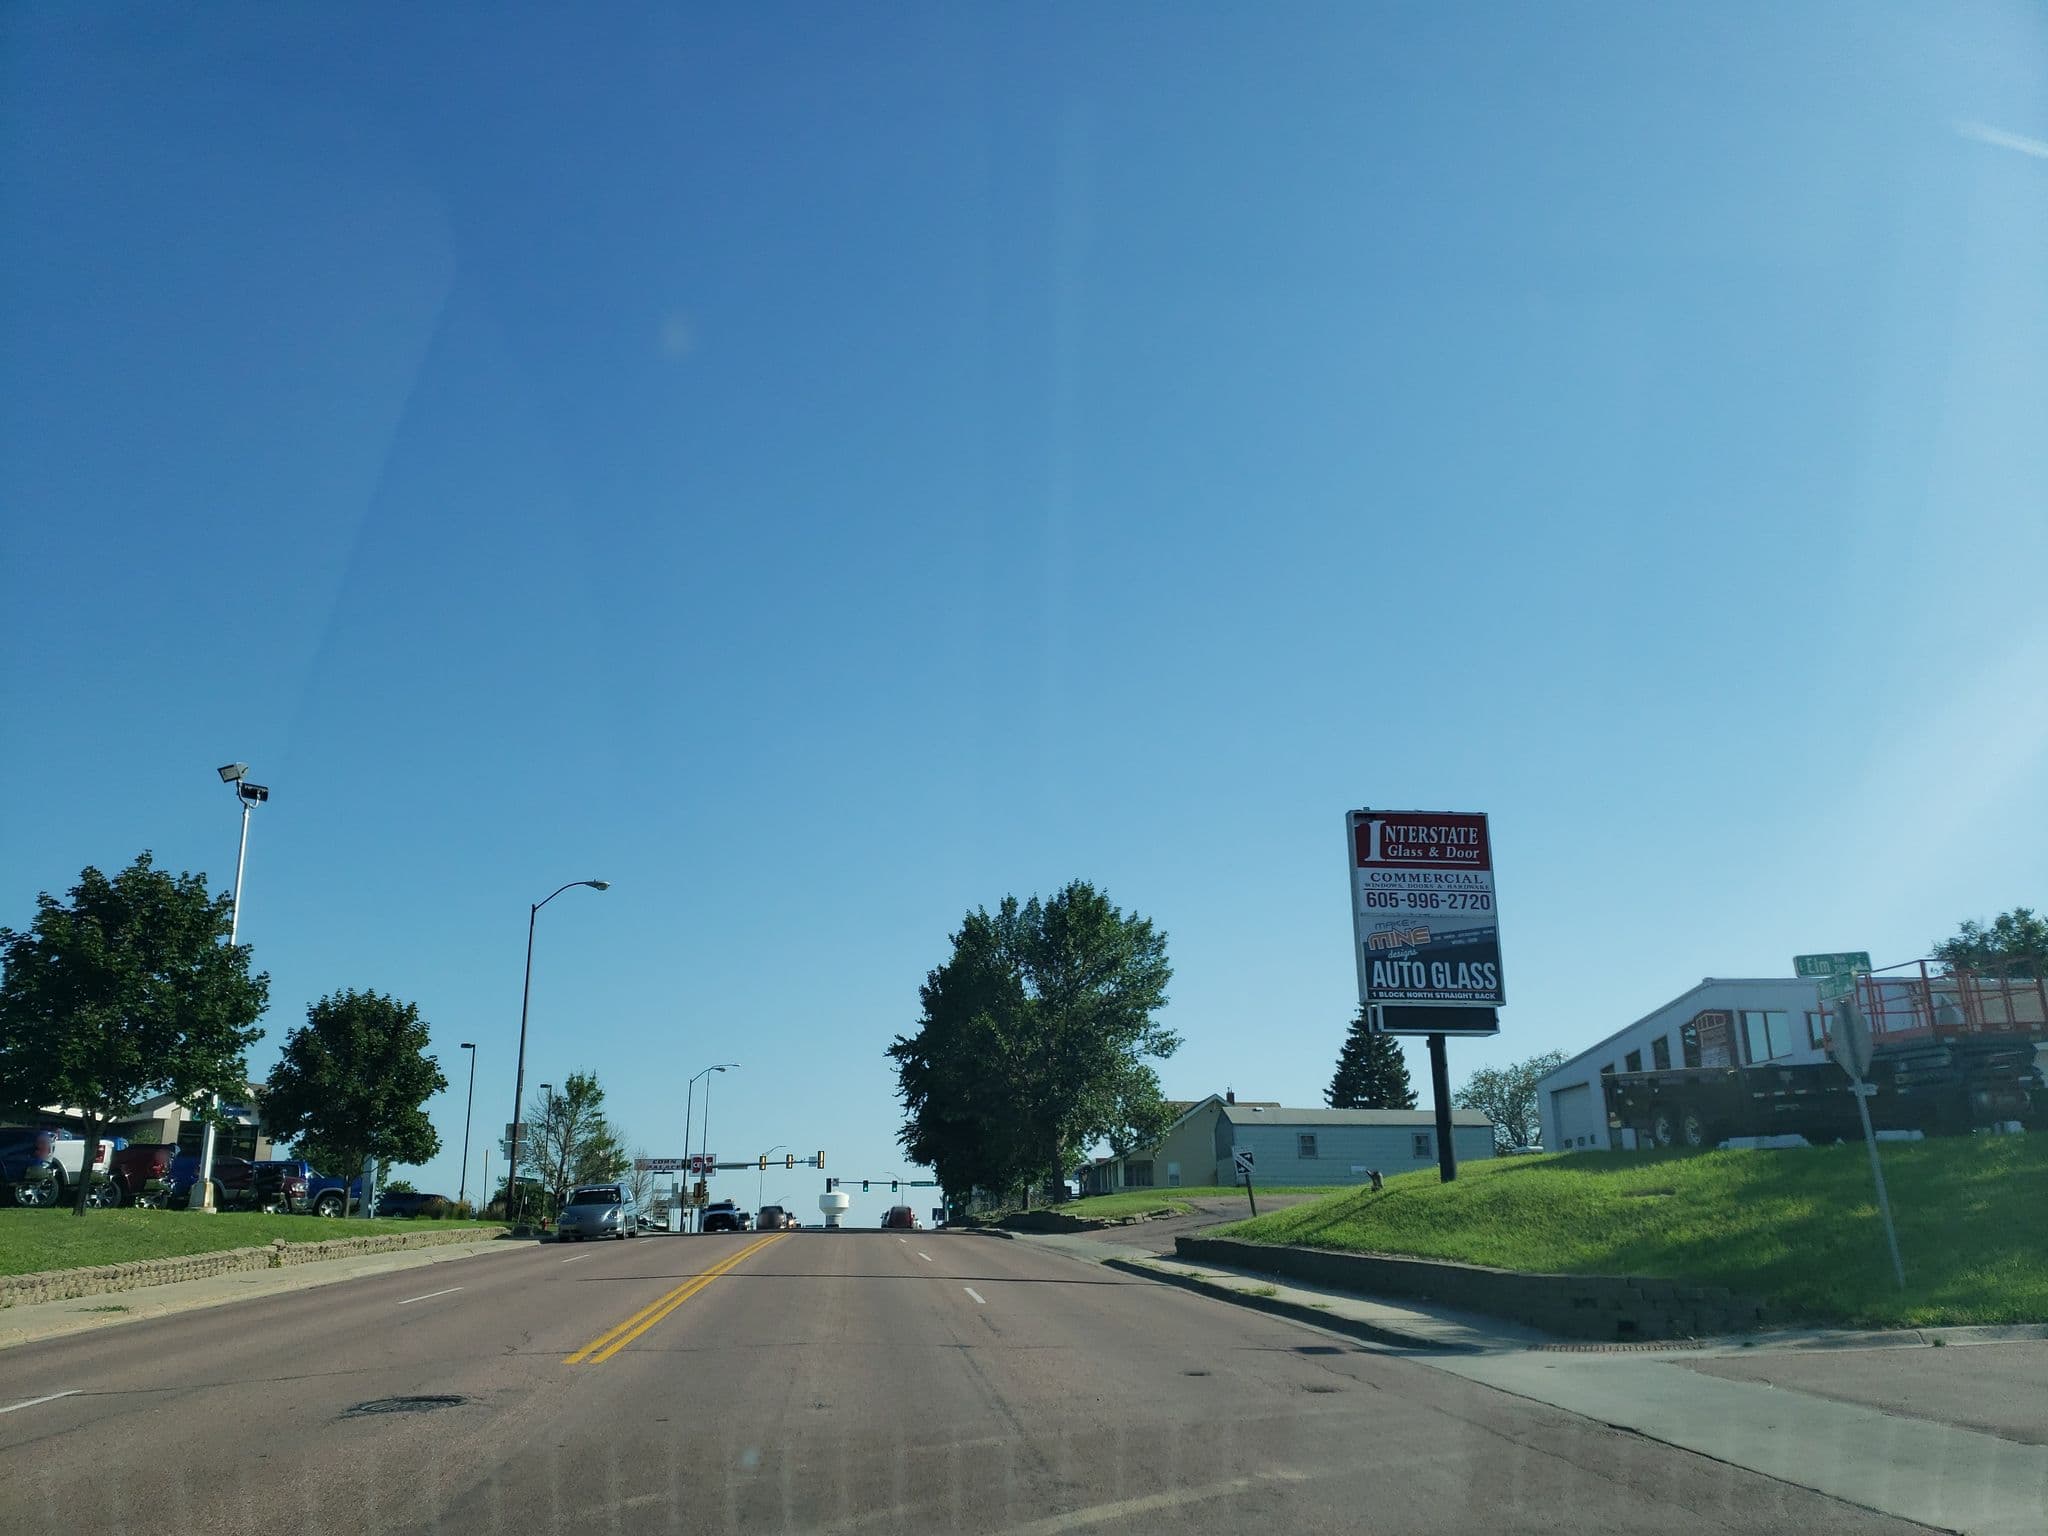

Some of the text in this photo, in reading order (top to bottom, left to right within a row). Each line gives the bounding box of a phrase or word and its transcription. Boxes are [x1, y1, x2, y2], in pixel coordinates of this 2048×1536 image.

[1364, 820, 1479, 861] INTERSTATE
[1387, 844, 1480, 858] Glass & Door
[1370, 872, 1484, 884] COMMERCIAL
[1366, 892, 1491, 910] 605-996-2720
[1368, 926, 1431, 951] MINE
[1388, 948, 1418, 961] designs
[1806, 957, 1831, 974] Elm
[1373, 960, 1497, 990] AUTO GLASS
